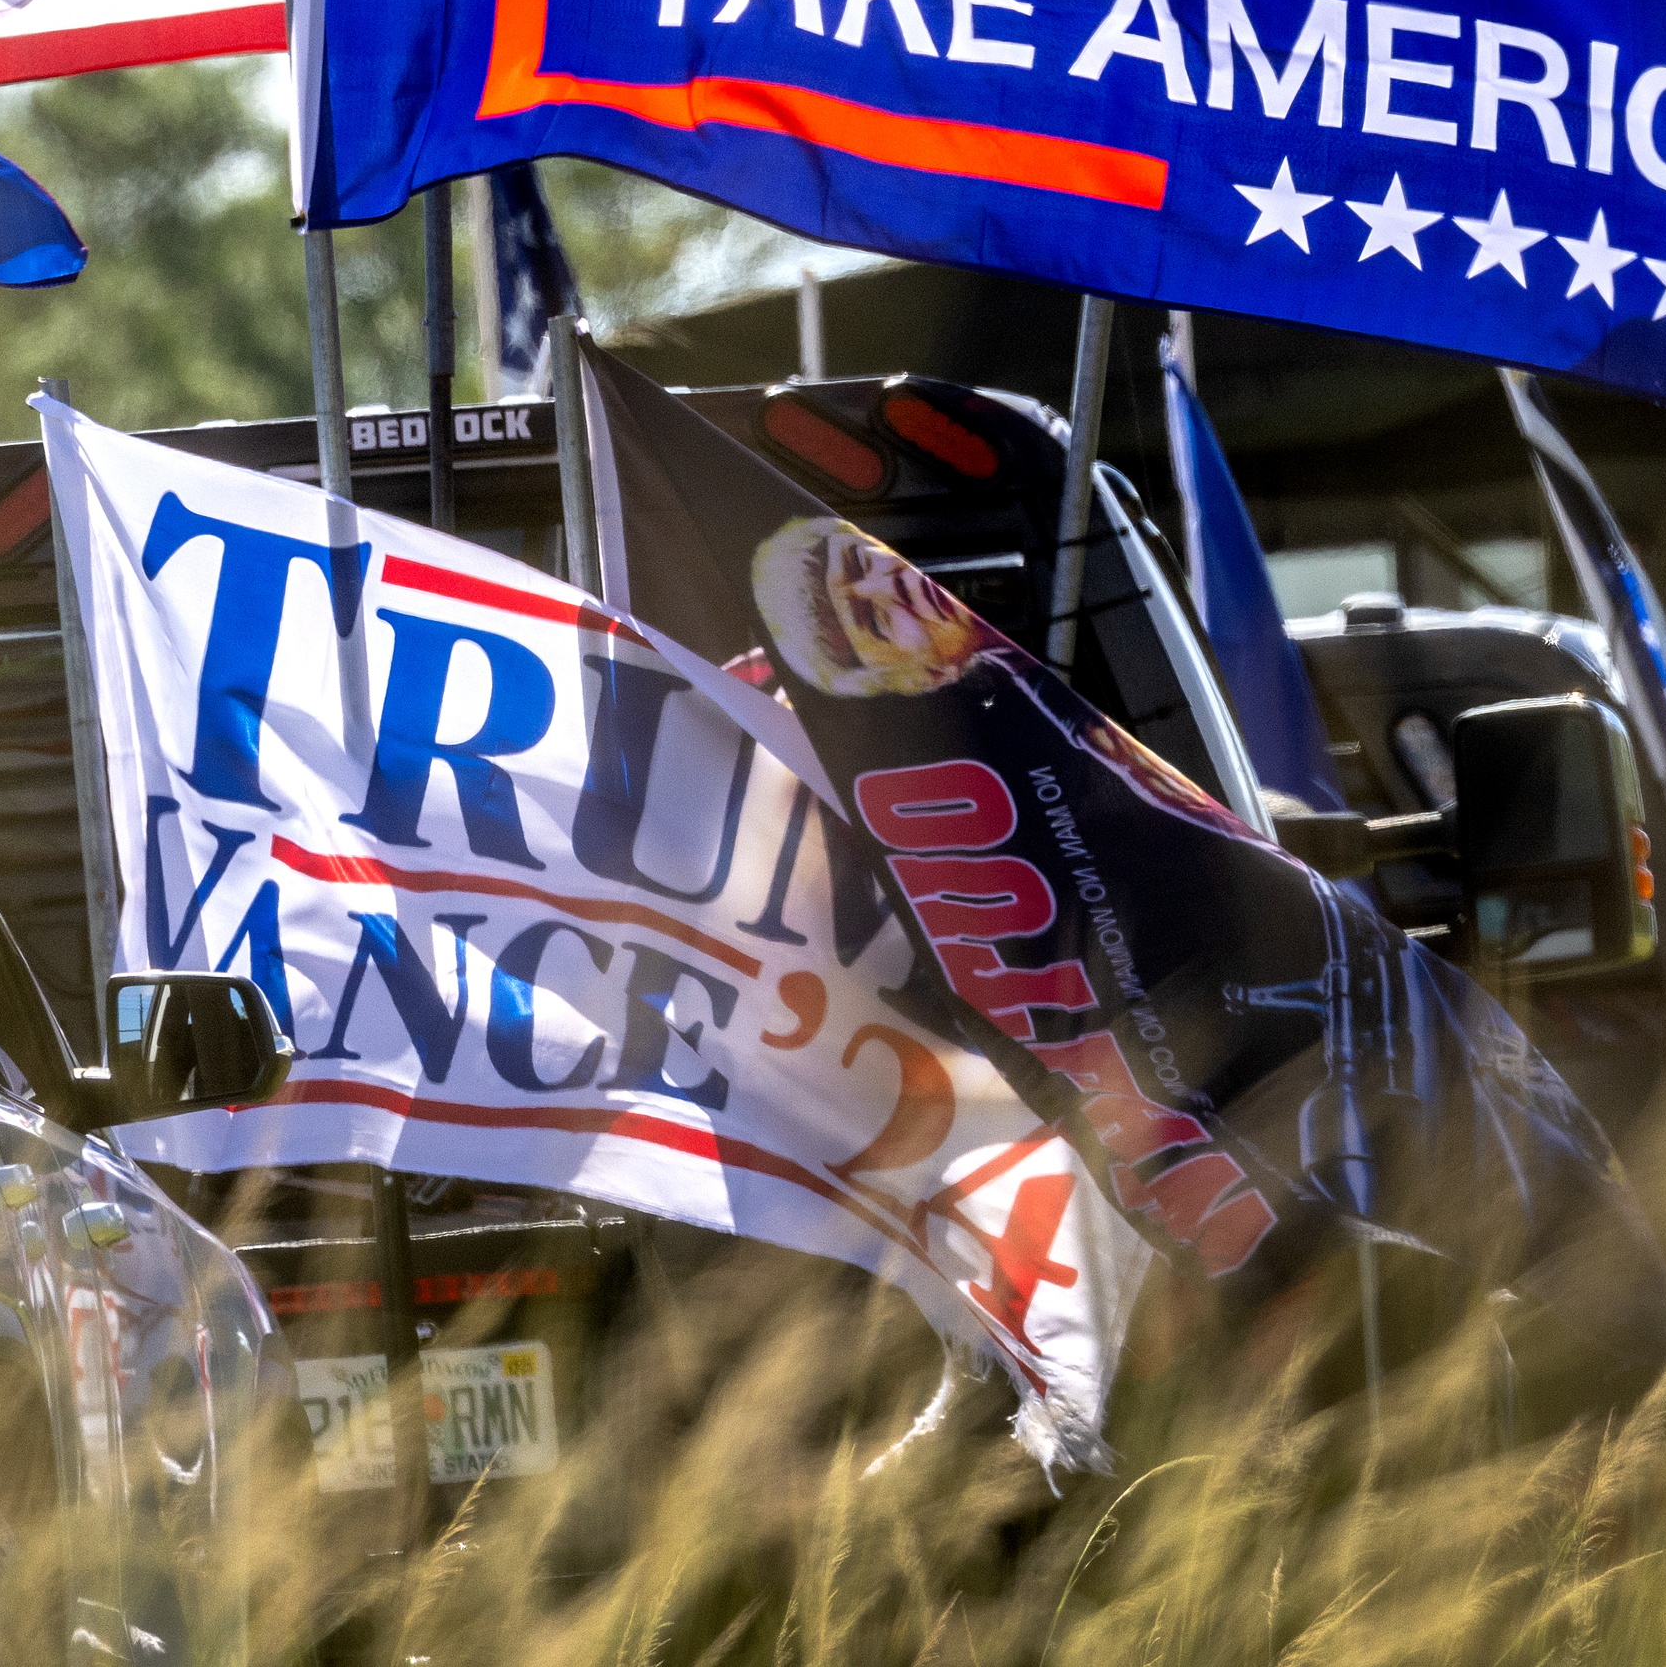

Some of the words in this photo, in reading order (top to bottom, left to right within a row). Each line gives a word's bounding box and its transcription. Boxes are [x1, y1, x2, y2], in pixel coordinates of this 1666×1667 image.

[351, 409, 531, 450] BEDOCK
[146, 796, 739, 1112] VANCE
[449, 1380, 539, 1449] RMN
